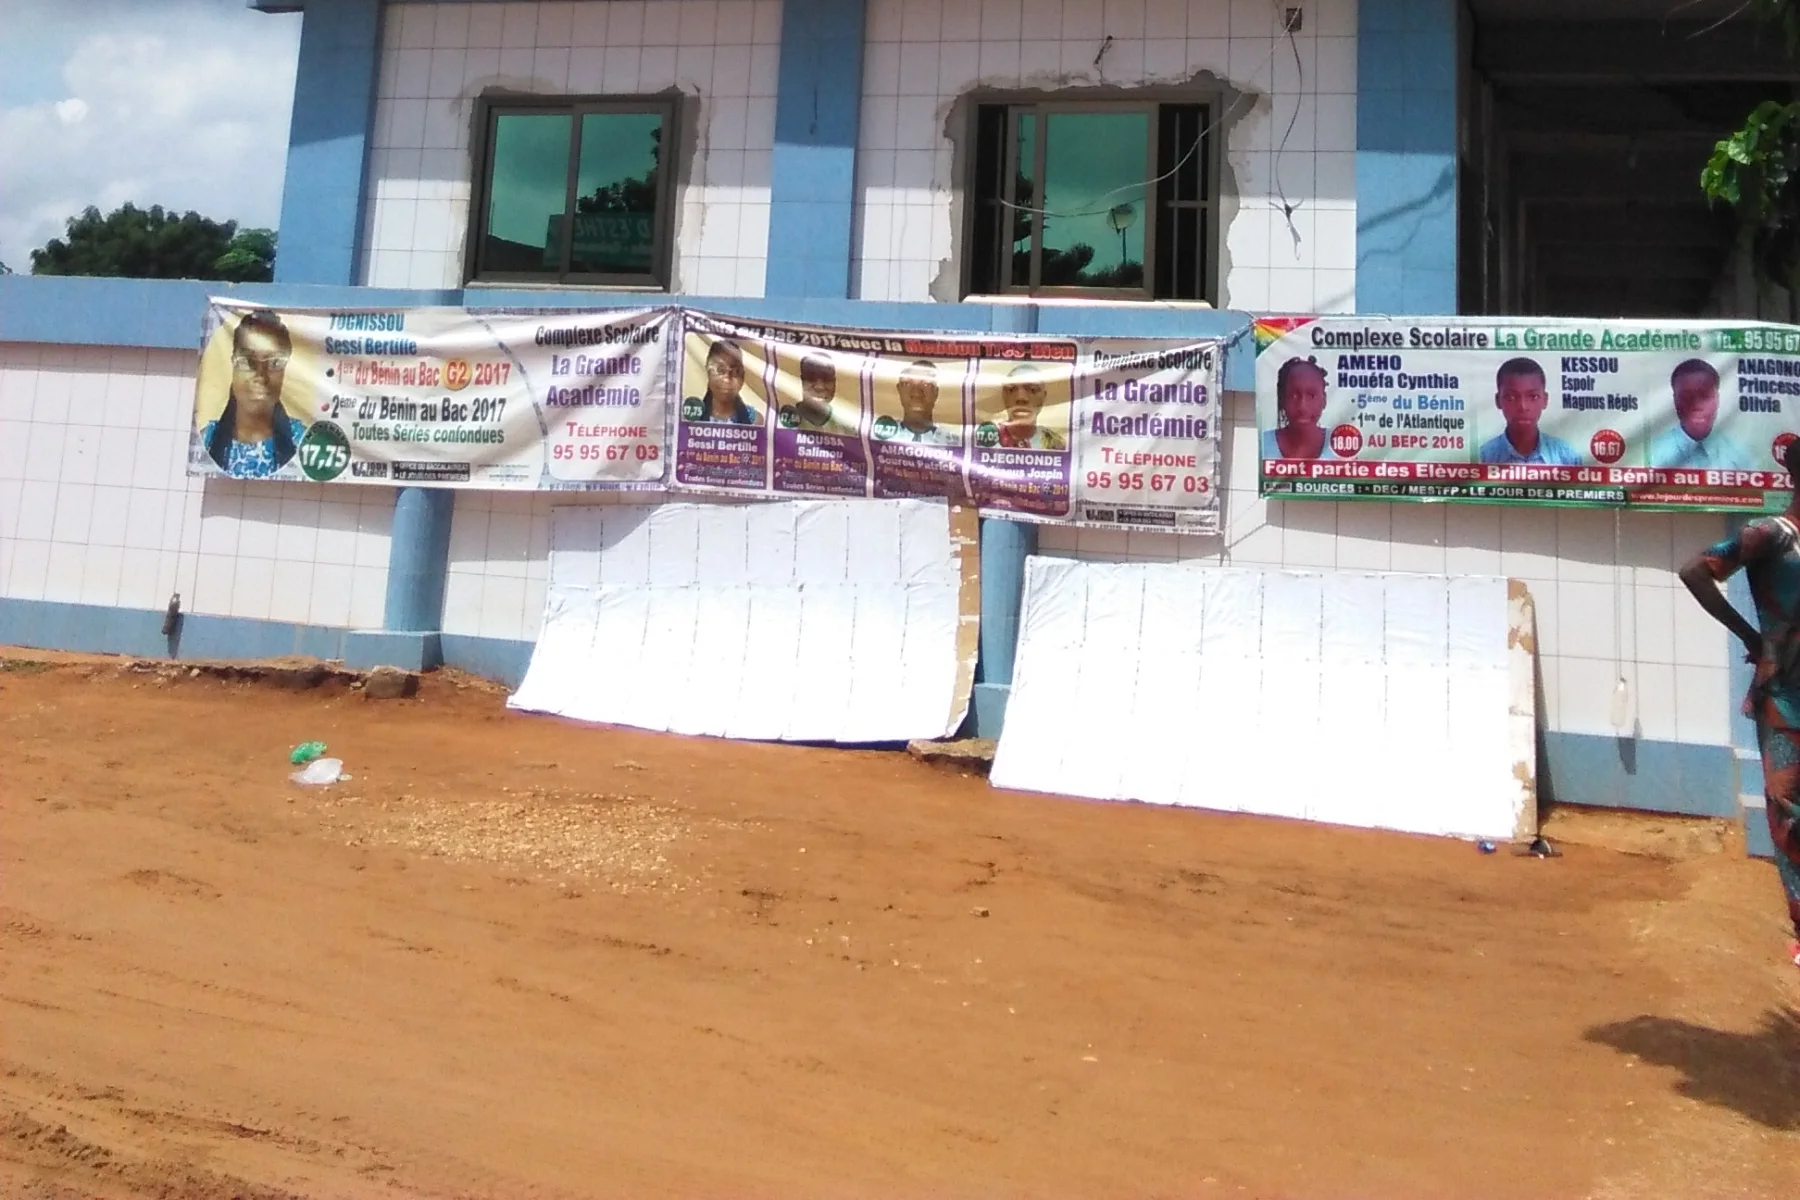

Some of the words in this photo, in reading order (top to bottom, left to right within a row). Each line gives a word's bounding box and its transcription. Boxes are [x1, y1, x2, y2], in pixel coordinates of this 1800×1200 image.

[329, 312, 405, 332] TOGNISSOU
[325, 336, 362, 355] Sessi
[365, 337, 418, 356] Bertille
[534, 325, 602, 349] Complexe
[603, 324, 660, 345] Scolaire
[762, 327, 797, 343] Bac
[798, 331, 837, 347] 2017
[840, 338, 882, 351] avec
[884, 338, 903, 352] la
[1311, 326, 1403, 352] Complexe
[1409, 326, 1488, 347] Scolaire
[1494, 328, 1517, 348] La
[1523, 328, 1595, 349] Grande
[1600, 328, 1701, 350] Académie
[1744, 331, 1763, 350] 95
[1765, 331, 1782, 351] 95
[1784, 333, 1800, 352] 67
[551, 354, 571, 376] La
[575, 353, 642, 376] Grande
[1093, 350, 1155, 370] Complexe
[1157, 350, 1212, 370] Scolaire
[1337, 354, 1402, 371] AMEHO
[1561, 356, 1619, 373] KESSOU
[355, 360, 369, 385] du
[370, 360, 401, 386] Bénin
[402, 367, 416, 386] au
[418, 361, 440, 387] Bac
[447, 361, 467, 385] G2
[474, 362, 511, 386] 2017
[1337, 372, 1394, 388] Houéfa
[1397, 373, 1459, 390] Cynthia
[1561, 374, 1595, 392] Espoir
[545, 384, 641, 407] Académie
[1094, 378, 1117, 402] La
[1123, 378, 1208, 405] Grande
[358, 396, 377, 420] du
[379, 396, 417, 421] Bénin
[420, 403, 437, 422] au
[441, 397, 468, 422] Bac
[471, 397, 507, 422] 2017
[682, 405, 703, 418] 17,75
[1392, 395, 1413, 410] du
[1417, 394, 1465, 411] Bénin
[1562, 393, 1606, 411] Magnus
[1607, 393, 1639, 411] Régis
[1738, 395, 1781, 413] Olivia
[352, 422, 390, 441] Toutes
[393, 422, 430, 443] Séries
[433, 425, 505, 444] confondues
[566, 421, 648, 438] TÉLÉPHONE
[1091, 411, 1208, 439] Académie
[1378, 414, 1394, 429] de
[1396, 414, 1465, 433] l'Atlantique
[687, 426, 758, 441] TOGNISSOU
[796, 433, 845, 447] MOUSSA
[1367, 435, 1387, 448] AU
[1391, 435, 1428, 449] BEPC
[1432, 436, 1464, 449] 2018
[553, 444, 573, 461] 95
[580, 444, 600, 461] 95
[606, 444, 629, 461] 67
[635, 444, 659, 461] 03
[687, 438, 715, 450] Sessi
[717, 440, 758, 452] Bertille
[797, 446, 844, 459] Salimou
[301, 444, 347, 471] 17,75
[981, 452, 1062, 467] DJEGNONDE
[1101, 447, 1196, 468] TÉLÉPHONE
[1027, 467, 1063, 481] Jospin
[1086, 471, 1111, 489] 95
[1118, 472, 1144, 490] 95
[1150, 474, 1176, 492] 67
[1183, 475, 1209, 493] 03
[1264, 460, 1306, 475] Font
[1311, 462, 1370, 478] partie
[1375, 462, 1410, 477] des
[1415, 463, 1481, 479] Elèves
[1487, 465, 1571, 481] Brillants
[1577, 468, 1602, 482] du
[1609, 468, 1668, 484] Bénin
[1674, 471, 1699, 485] au
[1706, 470, 1765, 487] BEPC
[1295, 482, 1355, 493] SOURCES
[1372, 484, 1399, 495] DEC
[1469, 486, 1486, 496] LE
[1488, 487, 1524, 497] JOUR
[1527, 488, 1554, 498] DES
[1556, 489, 1625, 500] PREMIERS
